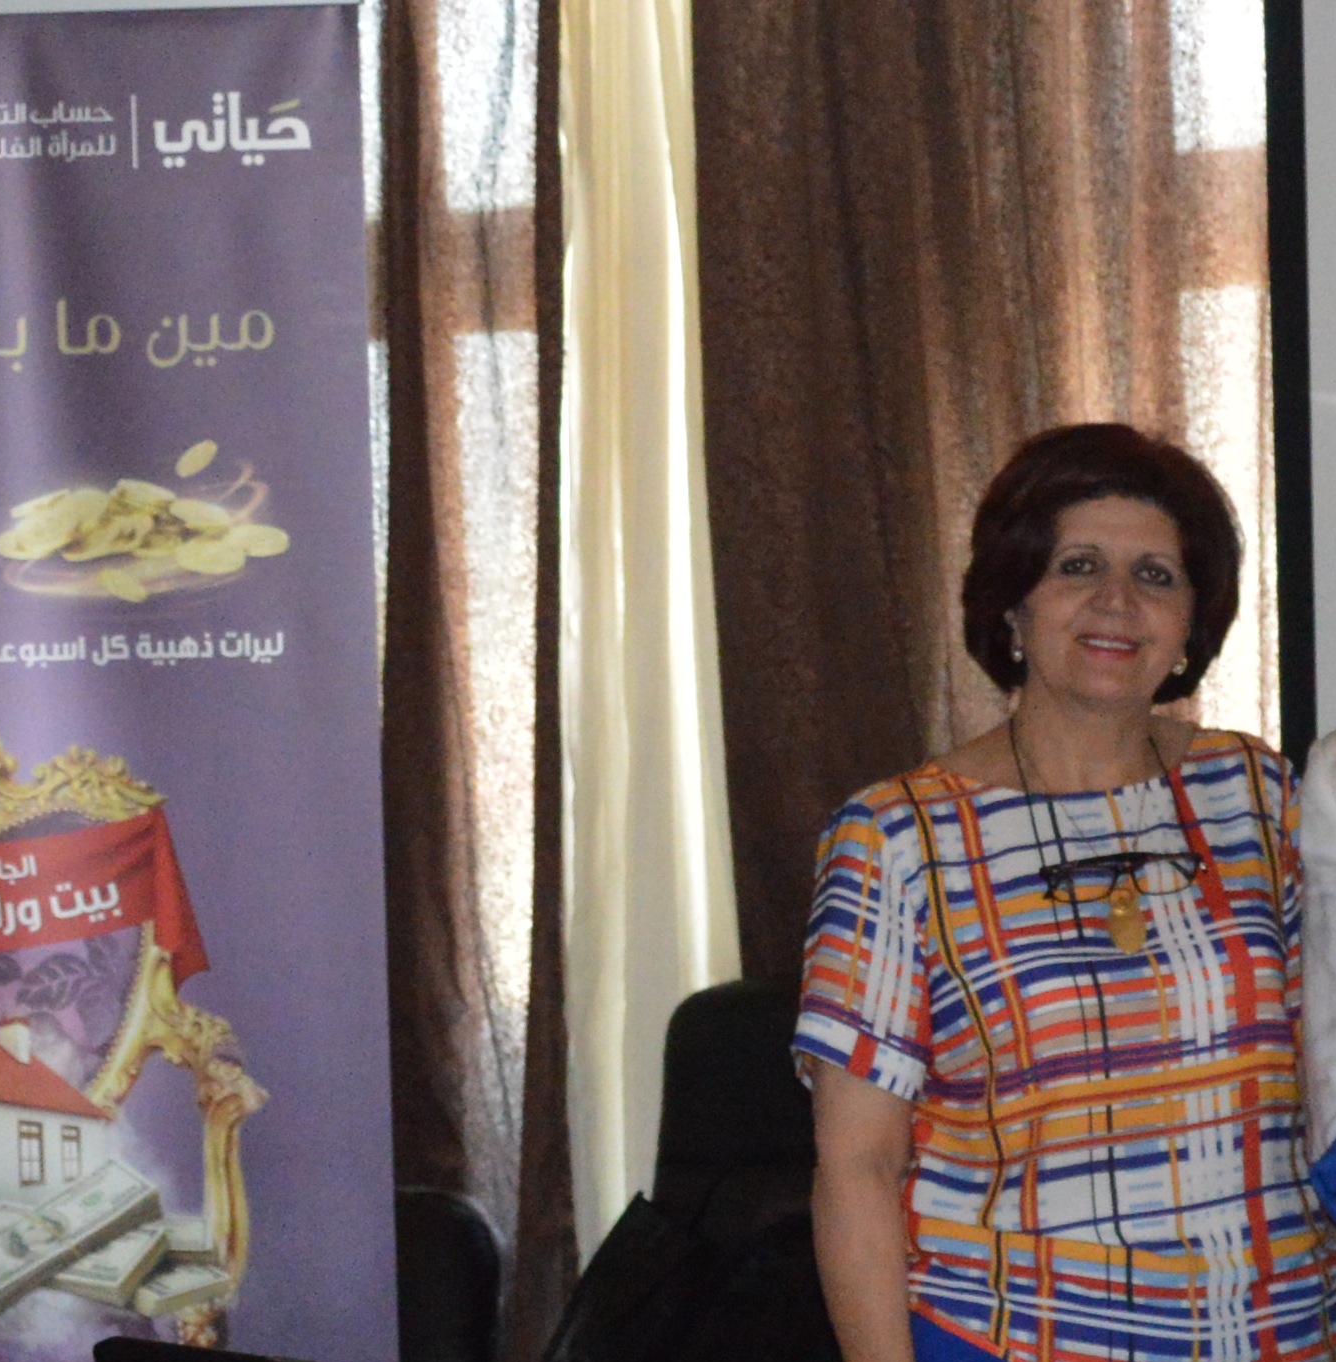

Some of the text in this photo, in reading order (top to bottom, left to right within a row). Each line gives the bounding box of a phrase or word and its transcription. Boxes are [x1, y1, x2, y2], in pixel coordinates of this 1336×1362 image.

[29, 100, 114, 128] حساب
[48, 130, 116, 162] للمرأة
[56, 299, 122, 355] ما
[146, 309, 275, 367] مين
[92, 634, 130, 666] كل
[135, 632, 214, 666] ذهبية
[219, 631, 284, 663] ليرات
[50, 881, 122, 923] بيت
